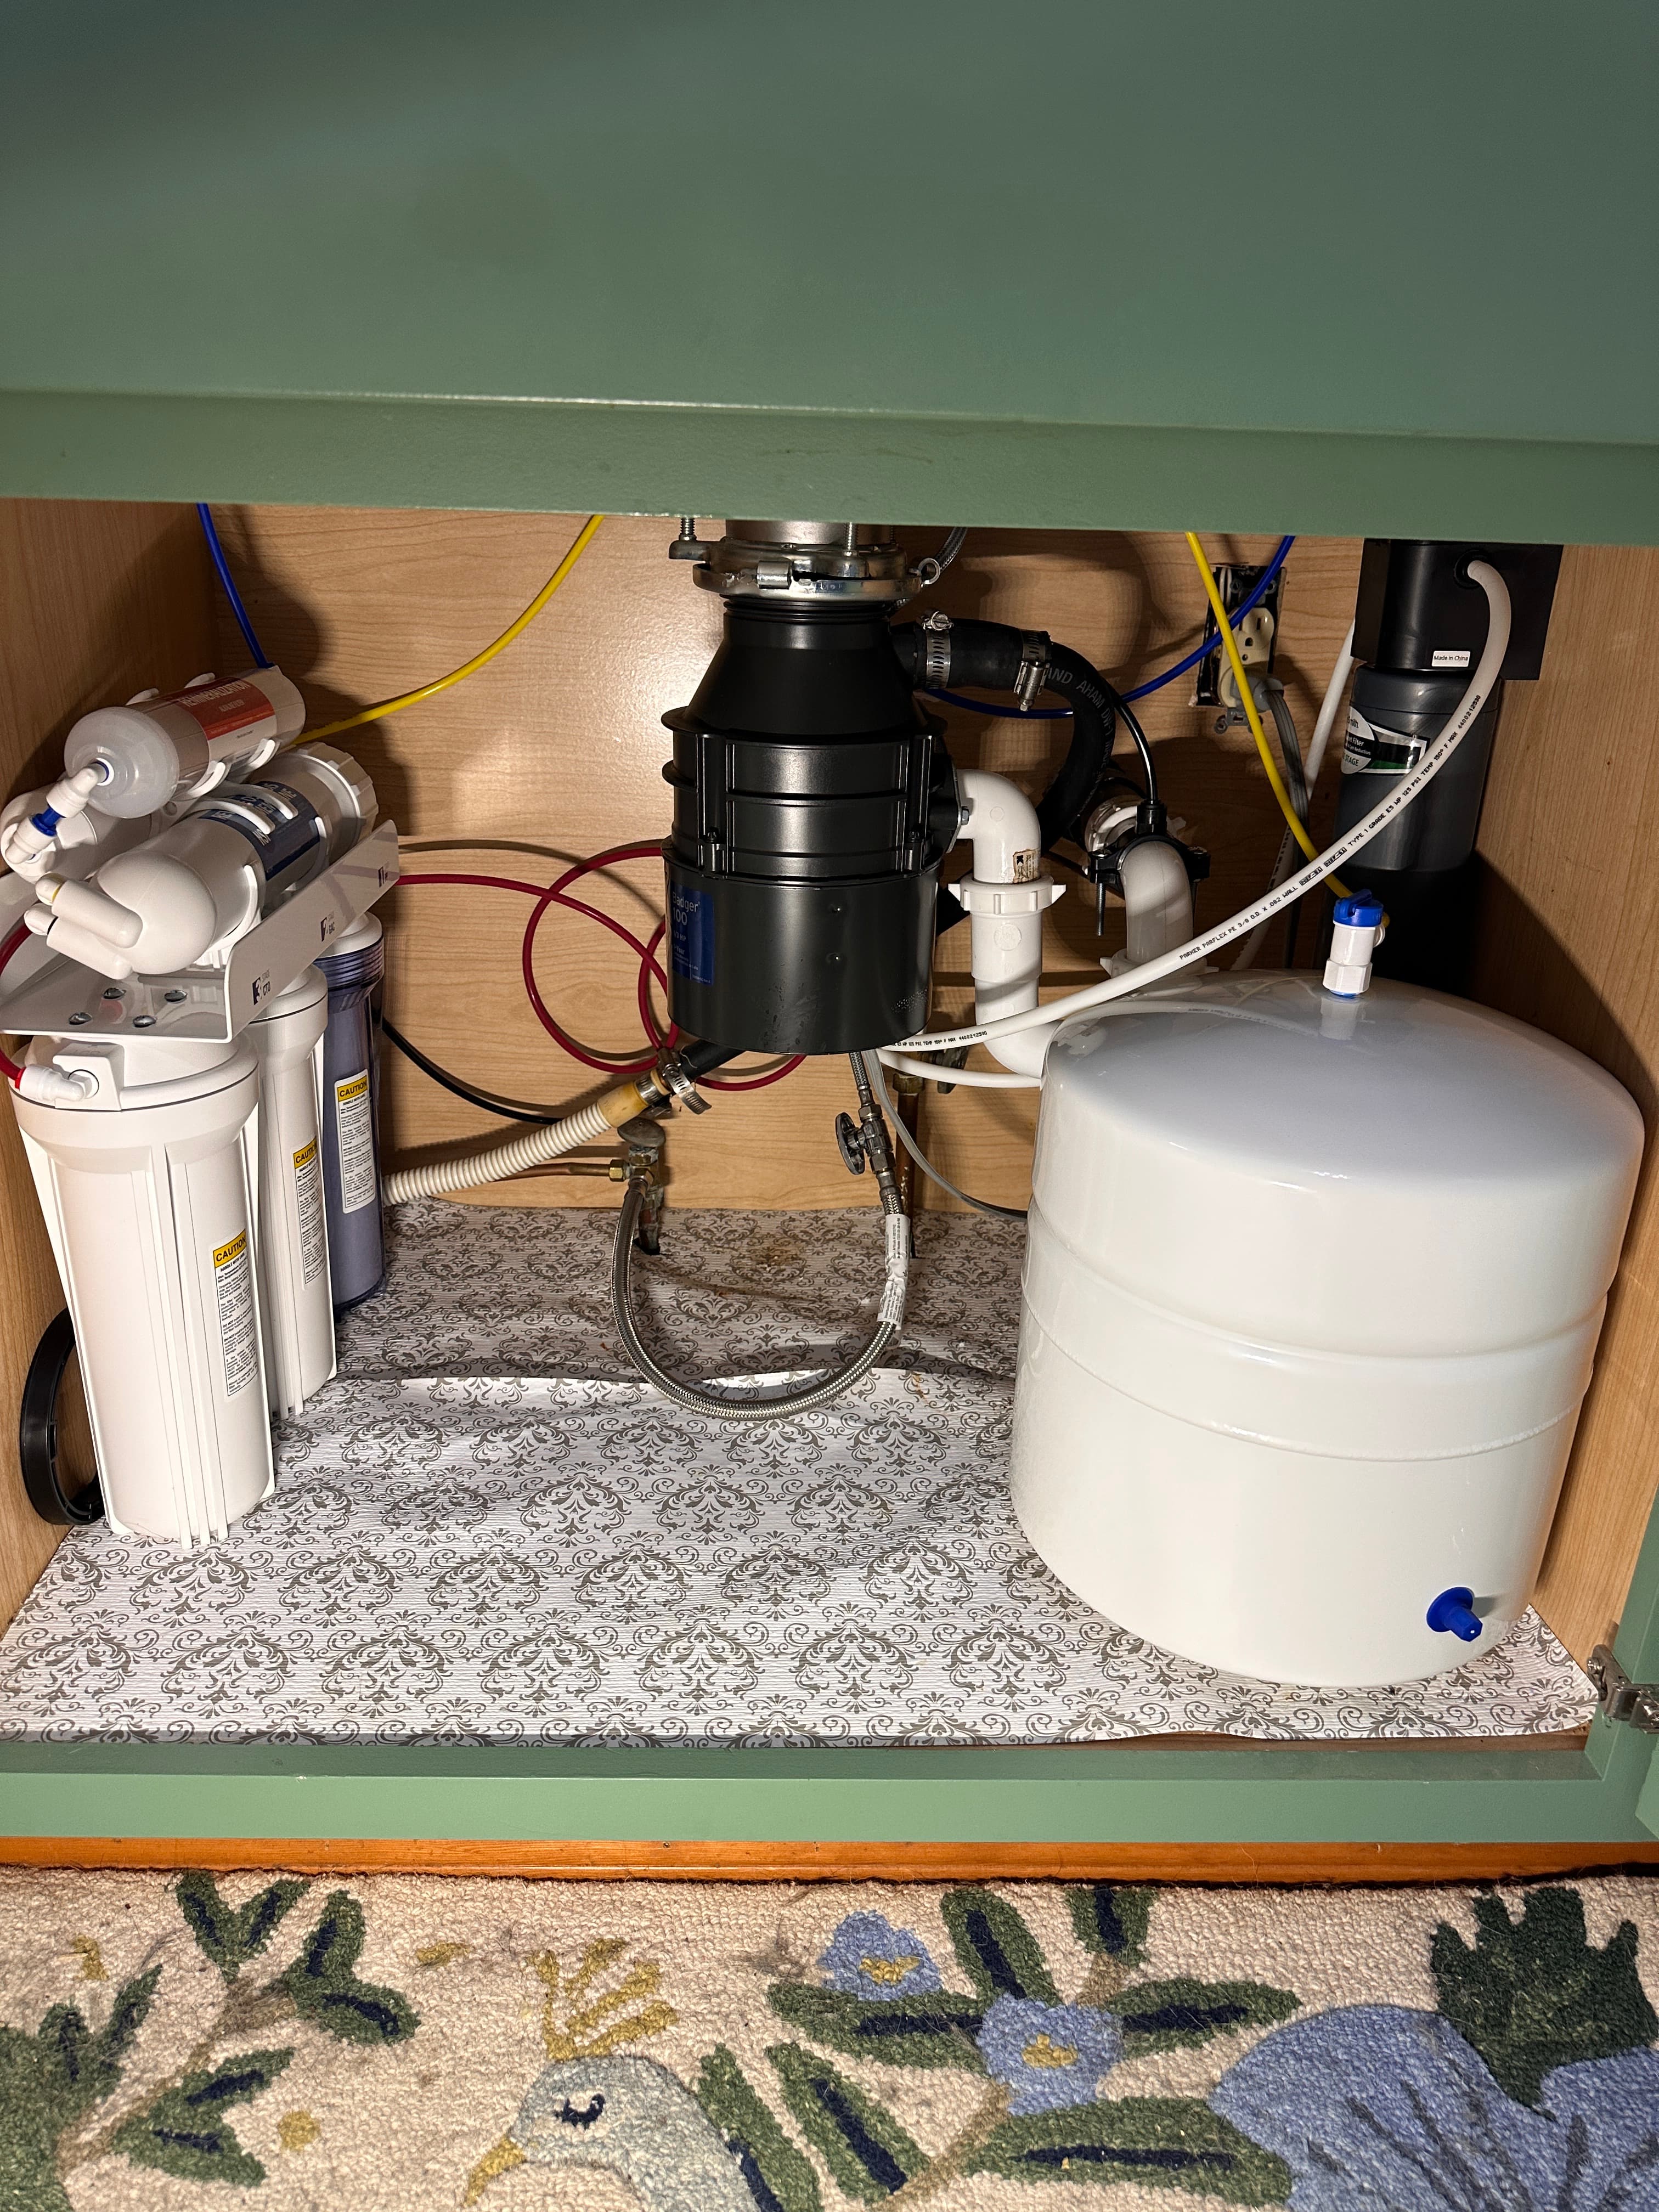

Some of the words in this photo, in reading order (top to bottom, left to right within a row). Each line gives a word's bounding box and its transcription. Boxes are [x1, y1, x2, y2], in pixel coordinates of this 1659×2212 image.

[1076, 680, 1105, 709] AHAM
[1352, 737, 1364, 747] Filter
[1345, 754, 1359, 766] STAGE
[1179, 946, 1201, 960] PARKER
[1202, 931, 1227, 949] PARFLEX
[1238, 918, 1249, 928] 3/8
[1269, 897, 1282, 909] .062
[1282, 886, 1298, 898] WALL
[1347, 832, 1364, 847] TYPE
[1368, 813, 1386, 829] GRADE
[1393, 797, 1402, 805] WP
[1402, 787, 1412, 796] 125
[1411, 776, 1422, 787] PSI
[1420, 761, 1434, 776] TEMP
[1448, 731, 1458, 743] MAX
[1458, 695, 1481, 729] 4400212530
[673, 907, 687, 926] 100
[680, 932, 686, 942] HP
[262, 981, 271, 996] CTO
[340, 1079, 367, 1097] CAUTION
[216, 1237, 246, 1262] CAUTION
